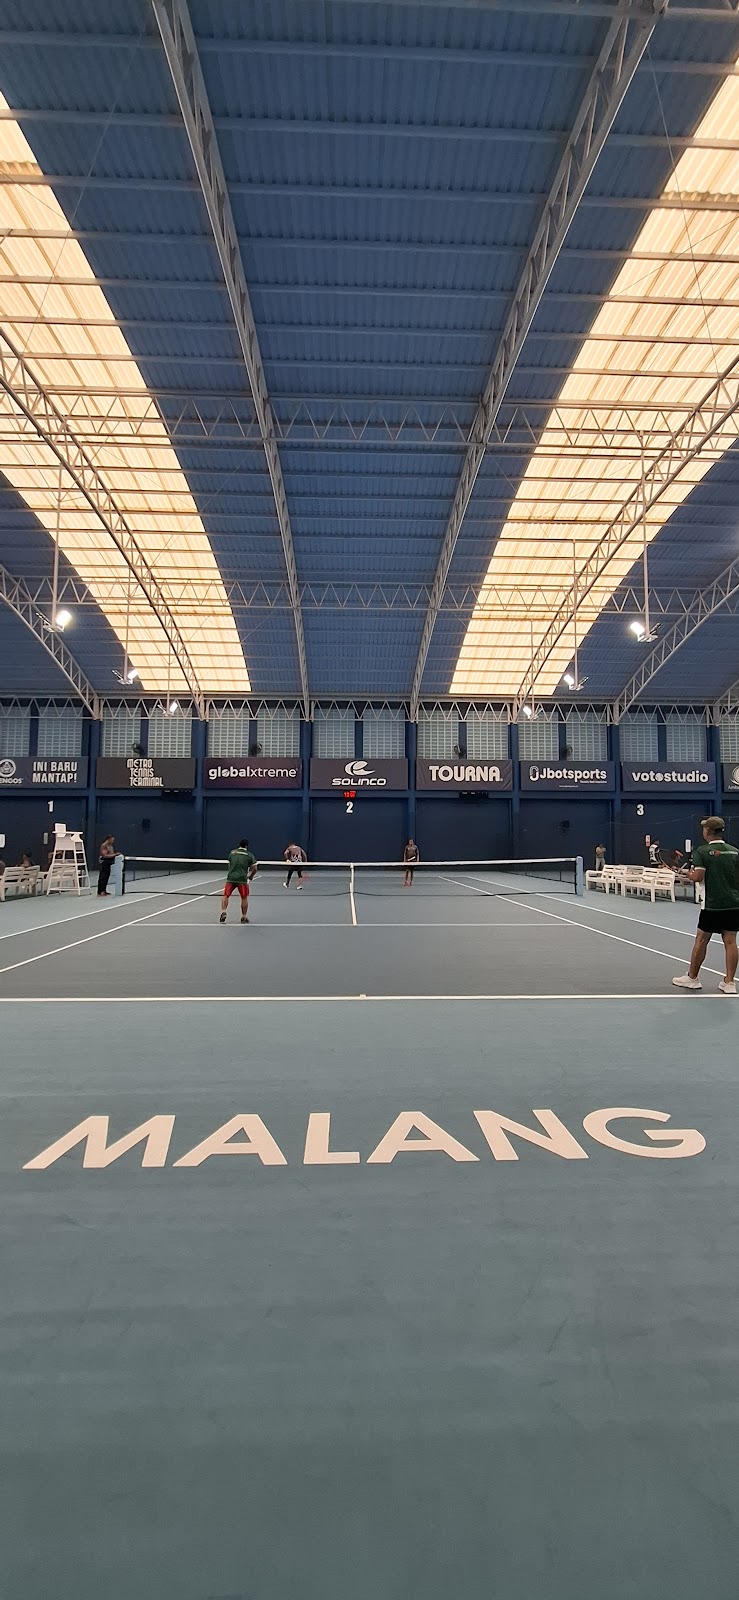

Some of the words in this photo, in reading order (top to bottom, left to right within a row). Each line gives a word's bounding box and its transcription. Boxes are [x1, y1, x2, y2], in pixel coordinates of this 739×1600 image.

[33, 761, 48, 772] INI
[50, 761, 78, 772] BARU
[126, 758, 153, 768] METRO
[32, 772, 77, 783] MANTAP!
[129, 767, 154, 777] TENNIS
[208, 766, 297, 780] globalxtreme
[428, 765, 500, 782] TOURNA
[539, 767, 607, 783] Jbotsports
[631, 770, 709, 782] votostudio
[129, 777, 165, 787] TERMINAL
[331, 778, 387, 786] SOLINCO
[47, 800, 54, 813] 1
[345, 801, 354, 814] 2
[636, 804, 645, 816] 3
[22, 1107, 707, 1170] MALANG
